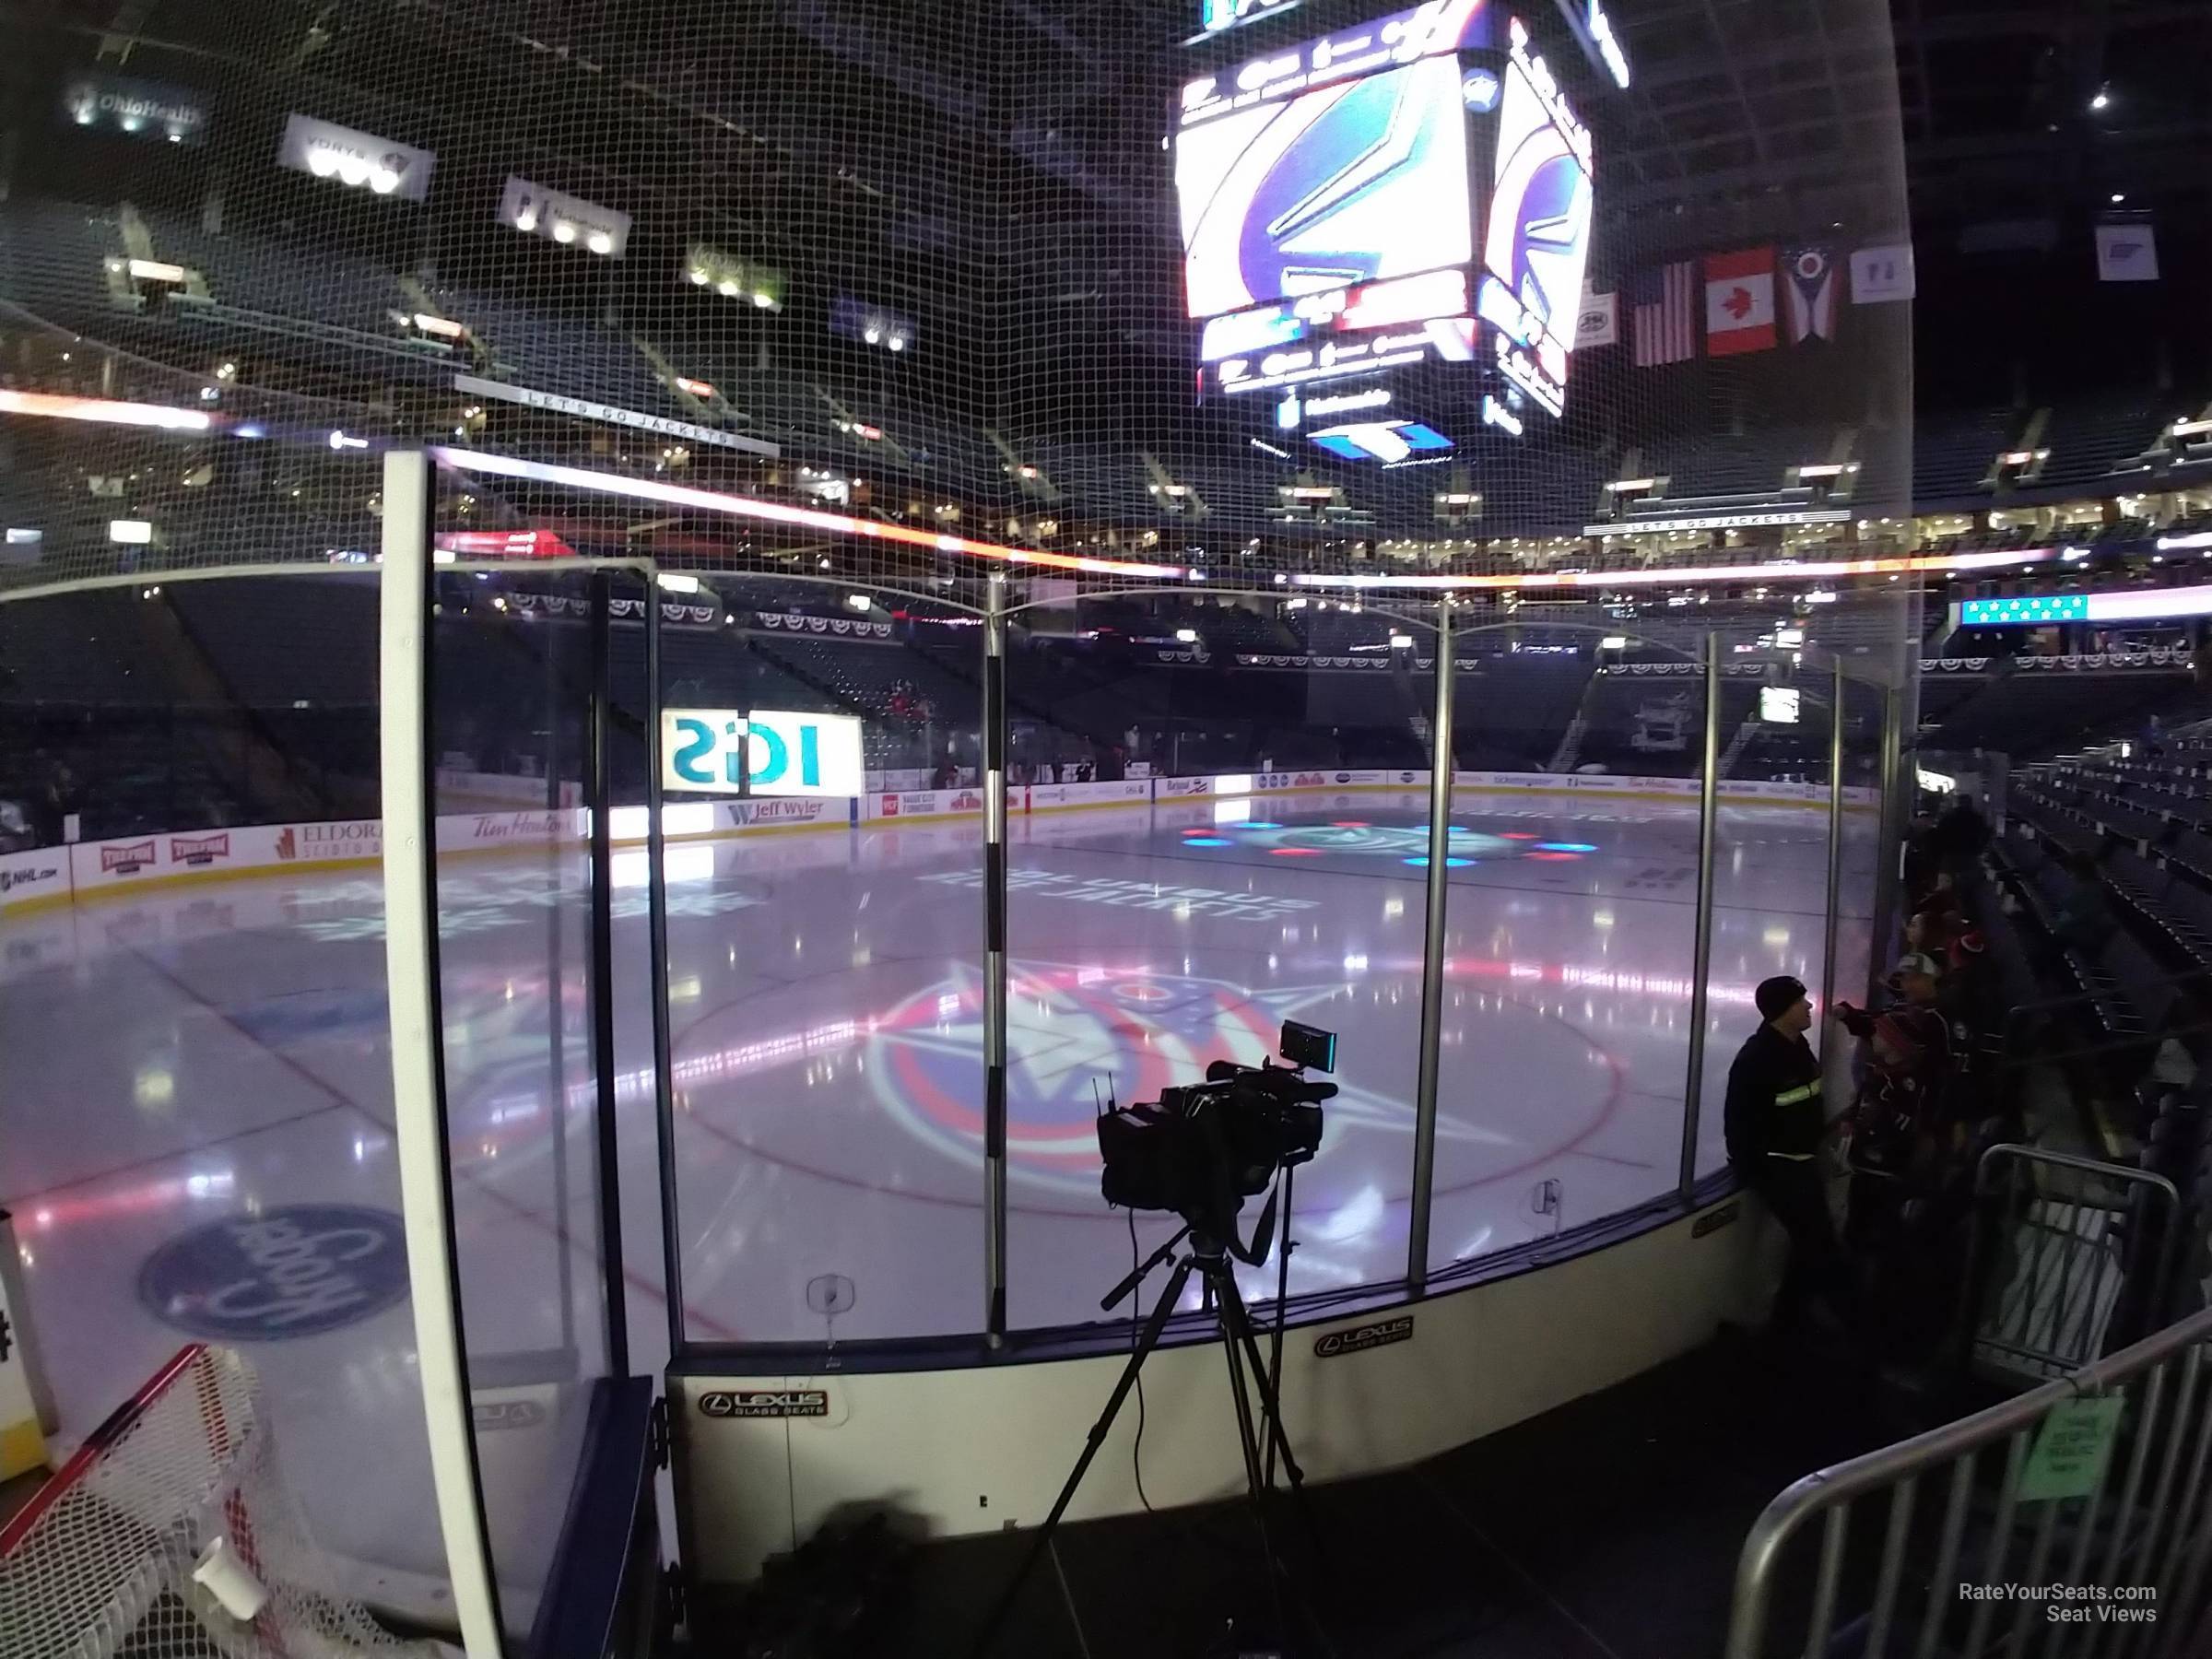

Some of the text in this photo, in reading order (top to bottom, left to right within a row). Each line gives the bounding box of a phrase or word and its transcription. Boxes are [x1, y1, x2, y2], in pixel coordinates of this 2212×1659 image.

[642, 418, 728, 444] JACKETS
[1688, 519, 1705, 527] GO
[1716, 514, 1797, 526] JACKETS
[755, 802, 823, 818] Jeff Wyler
[303, 824, 382, 842] ELDOR
[473, 817, 508, 838] Tim
[1344, 1320, 1411, 1343] LEXUS
[735, 1393, 824, 1406] LEXUS
[735, 1406, 825, 1416] GLASS SEATS
